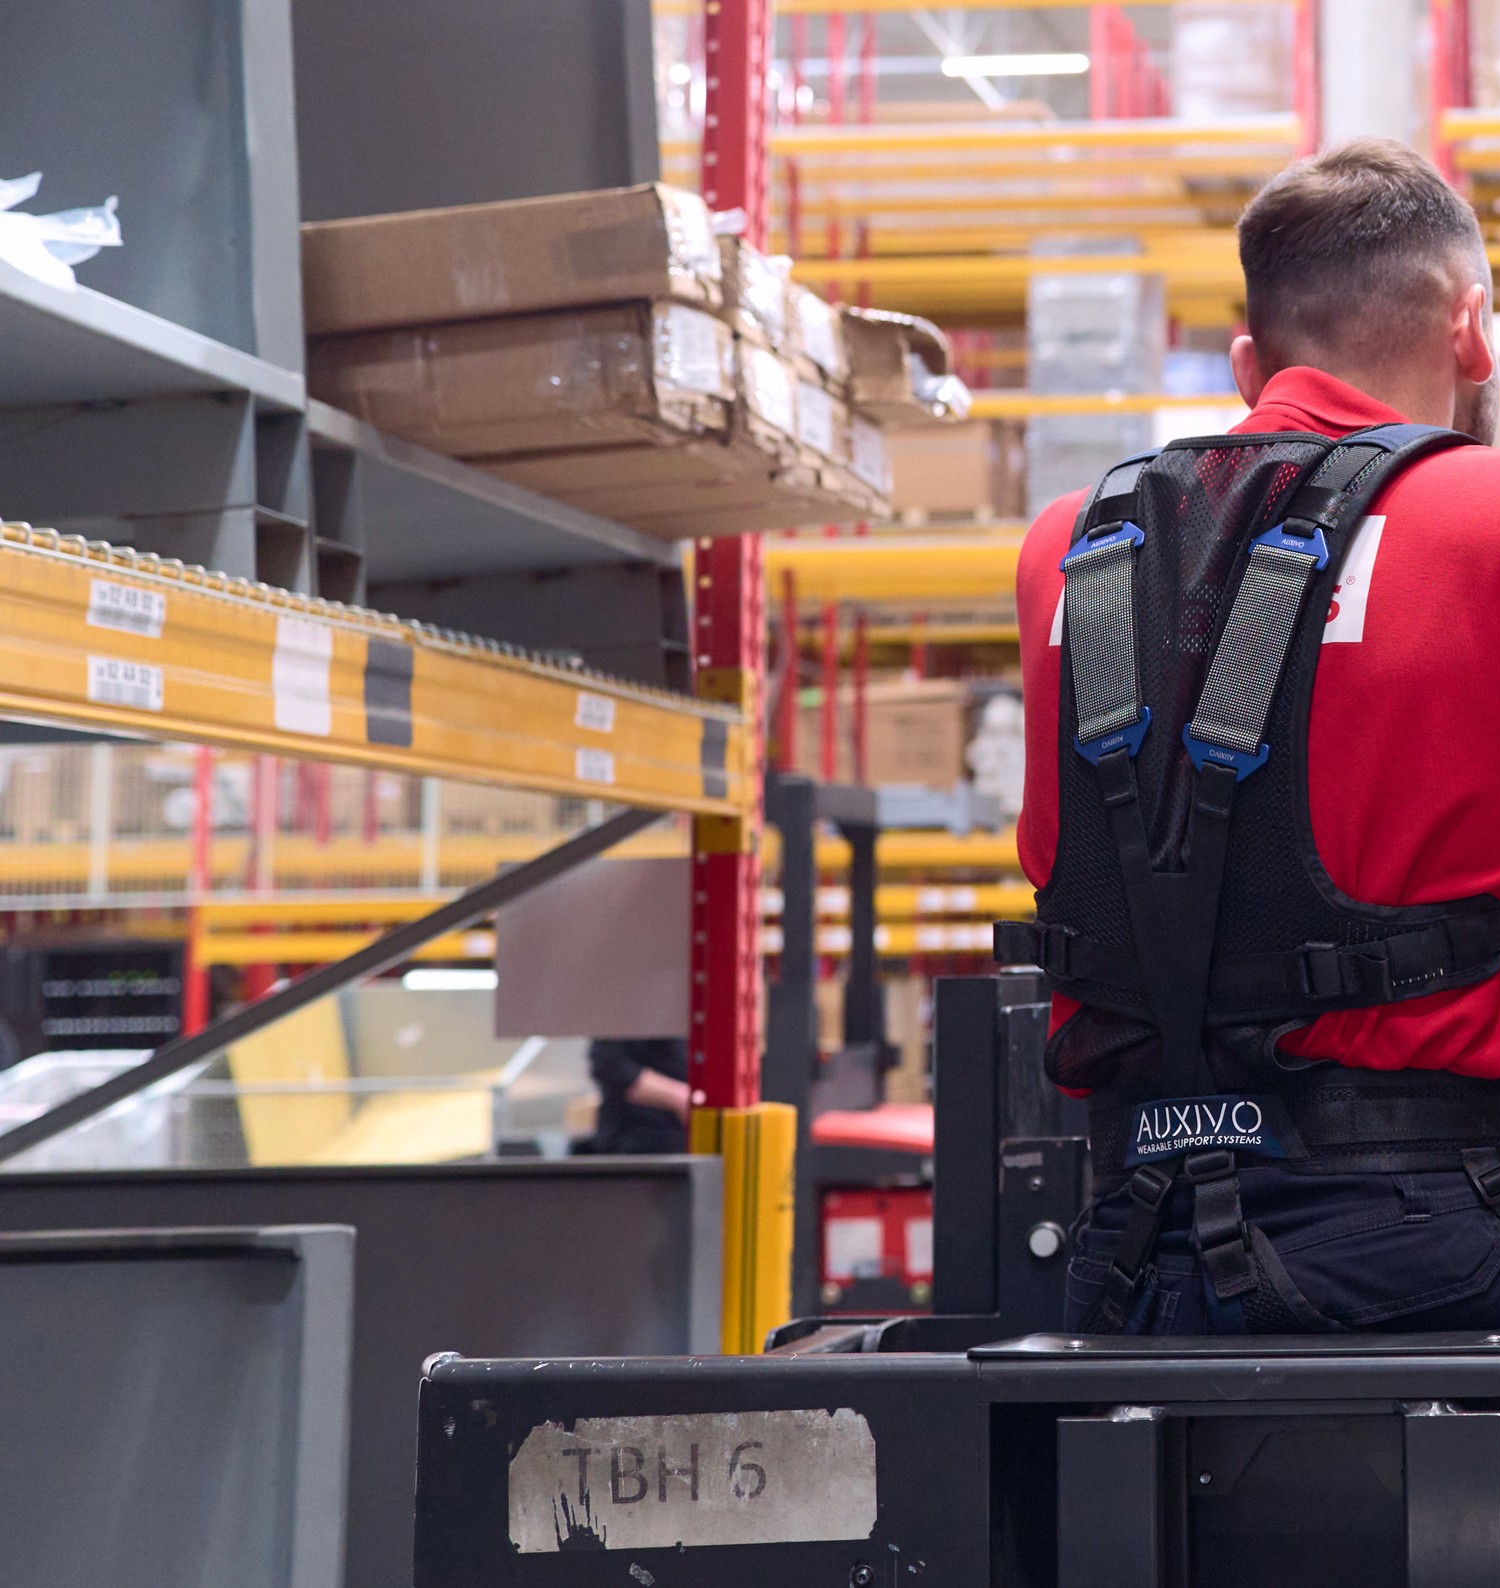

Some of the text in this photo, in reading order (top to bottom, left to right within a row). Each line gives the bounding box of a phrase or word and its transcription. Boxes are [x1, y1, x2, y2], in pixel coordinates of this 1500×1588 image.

[1090, 536, 1116, 549] AUXIVO
[1281, 538, 1305, 549] AUXIVO
[1101, 735, 1124, 750] AUXIVO
[1209, 749, 1235, 762] AUXIVO
[1136, 1101, 1262, 1143] AUXIVO
[1137, 1135, 1262, 1155] WEARABLE SUPPORT SYSTEMS
[562, 1440, 767, 1505] TBH 6
